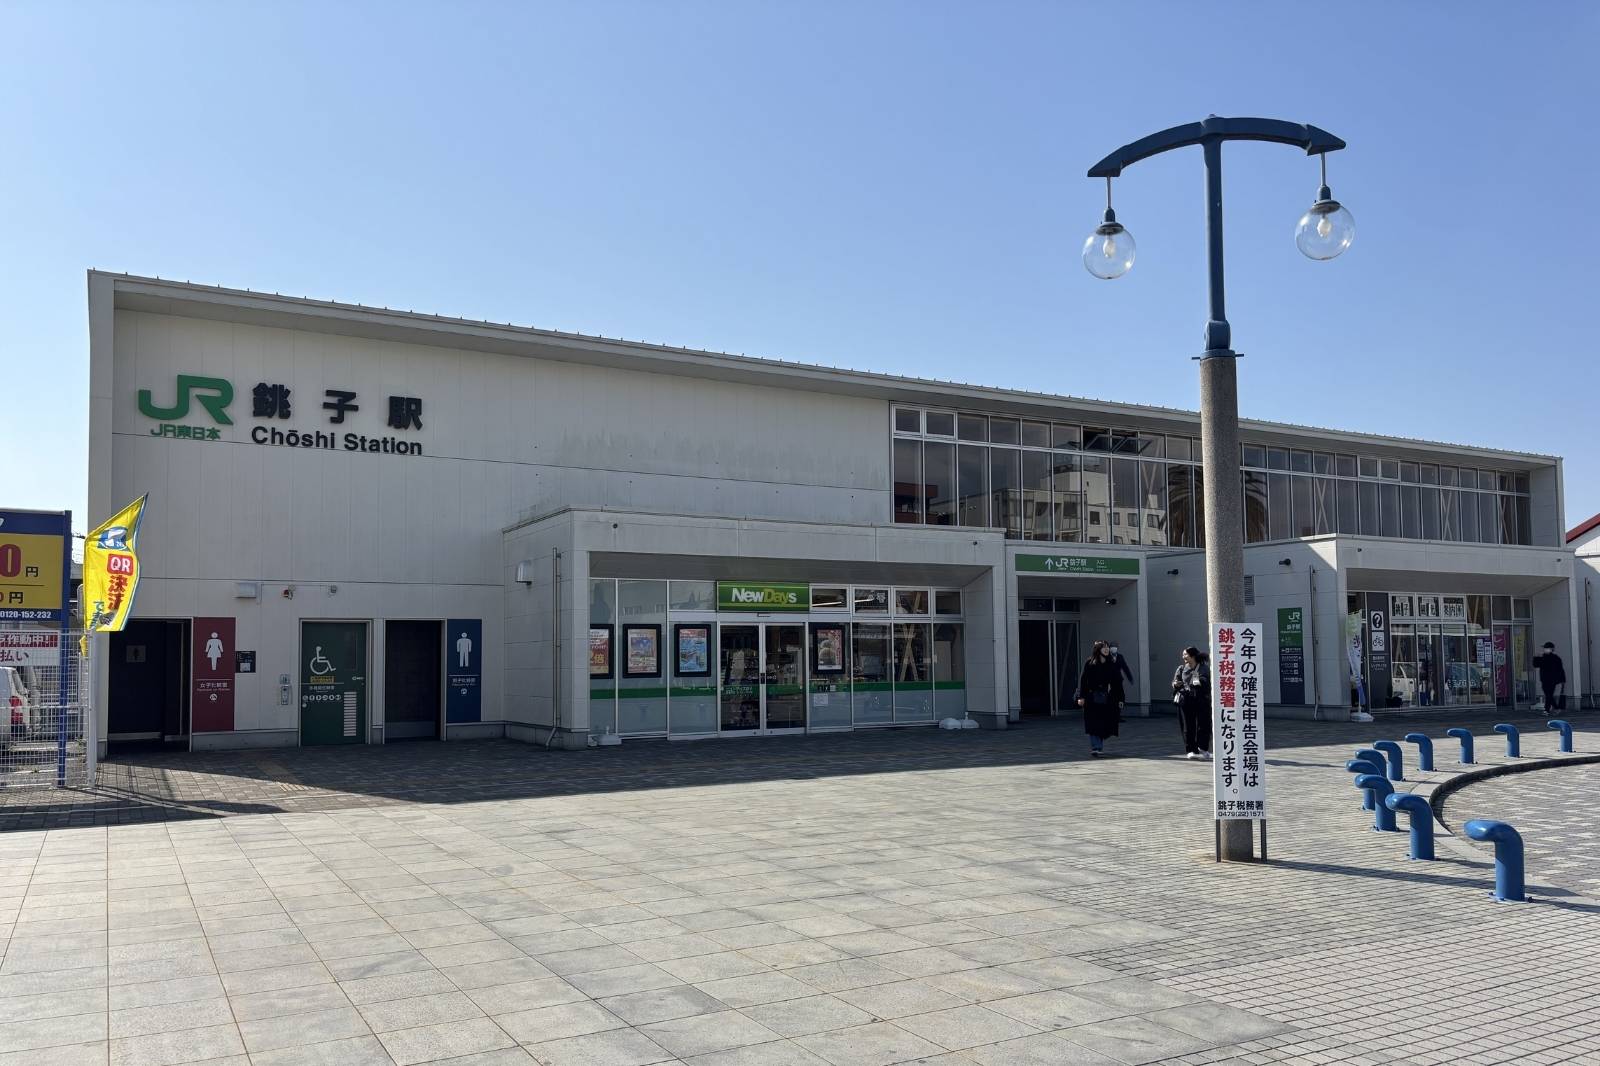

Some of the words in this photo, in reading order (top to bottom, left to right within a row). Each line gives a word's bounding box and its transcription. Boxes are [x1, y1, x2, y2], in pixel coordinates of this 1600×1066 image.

[138, 374, 234, 425] JR
[252, 382, 423, 430] 銚子駅
[150, 424, 221, 441] JR東日本
[251, 426, 336, 449] Chōshi
[343, 434, 423, 456] Station
[110, 556, 131, 573] QR
[1056, 558, 1069, 568] JR
[731, 587, 797, 604] NewDays
[1217, 627, 1237, 793] 銚子税務署になります。
[1240, 627, 1258, 787] 今年の確定申告会場は
[1217, 800, 1264, 811] 銚子税務署
